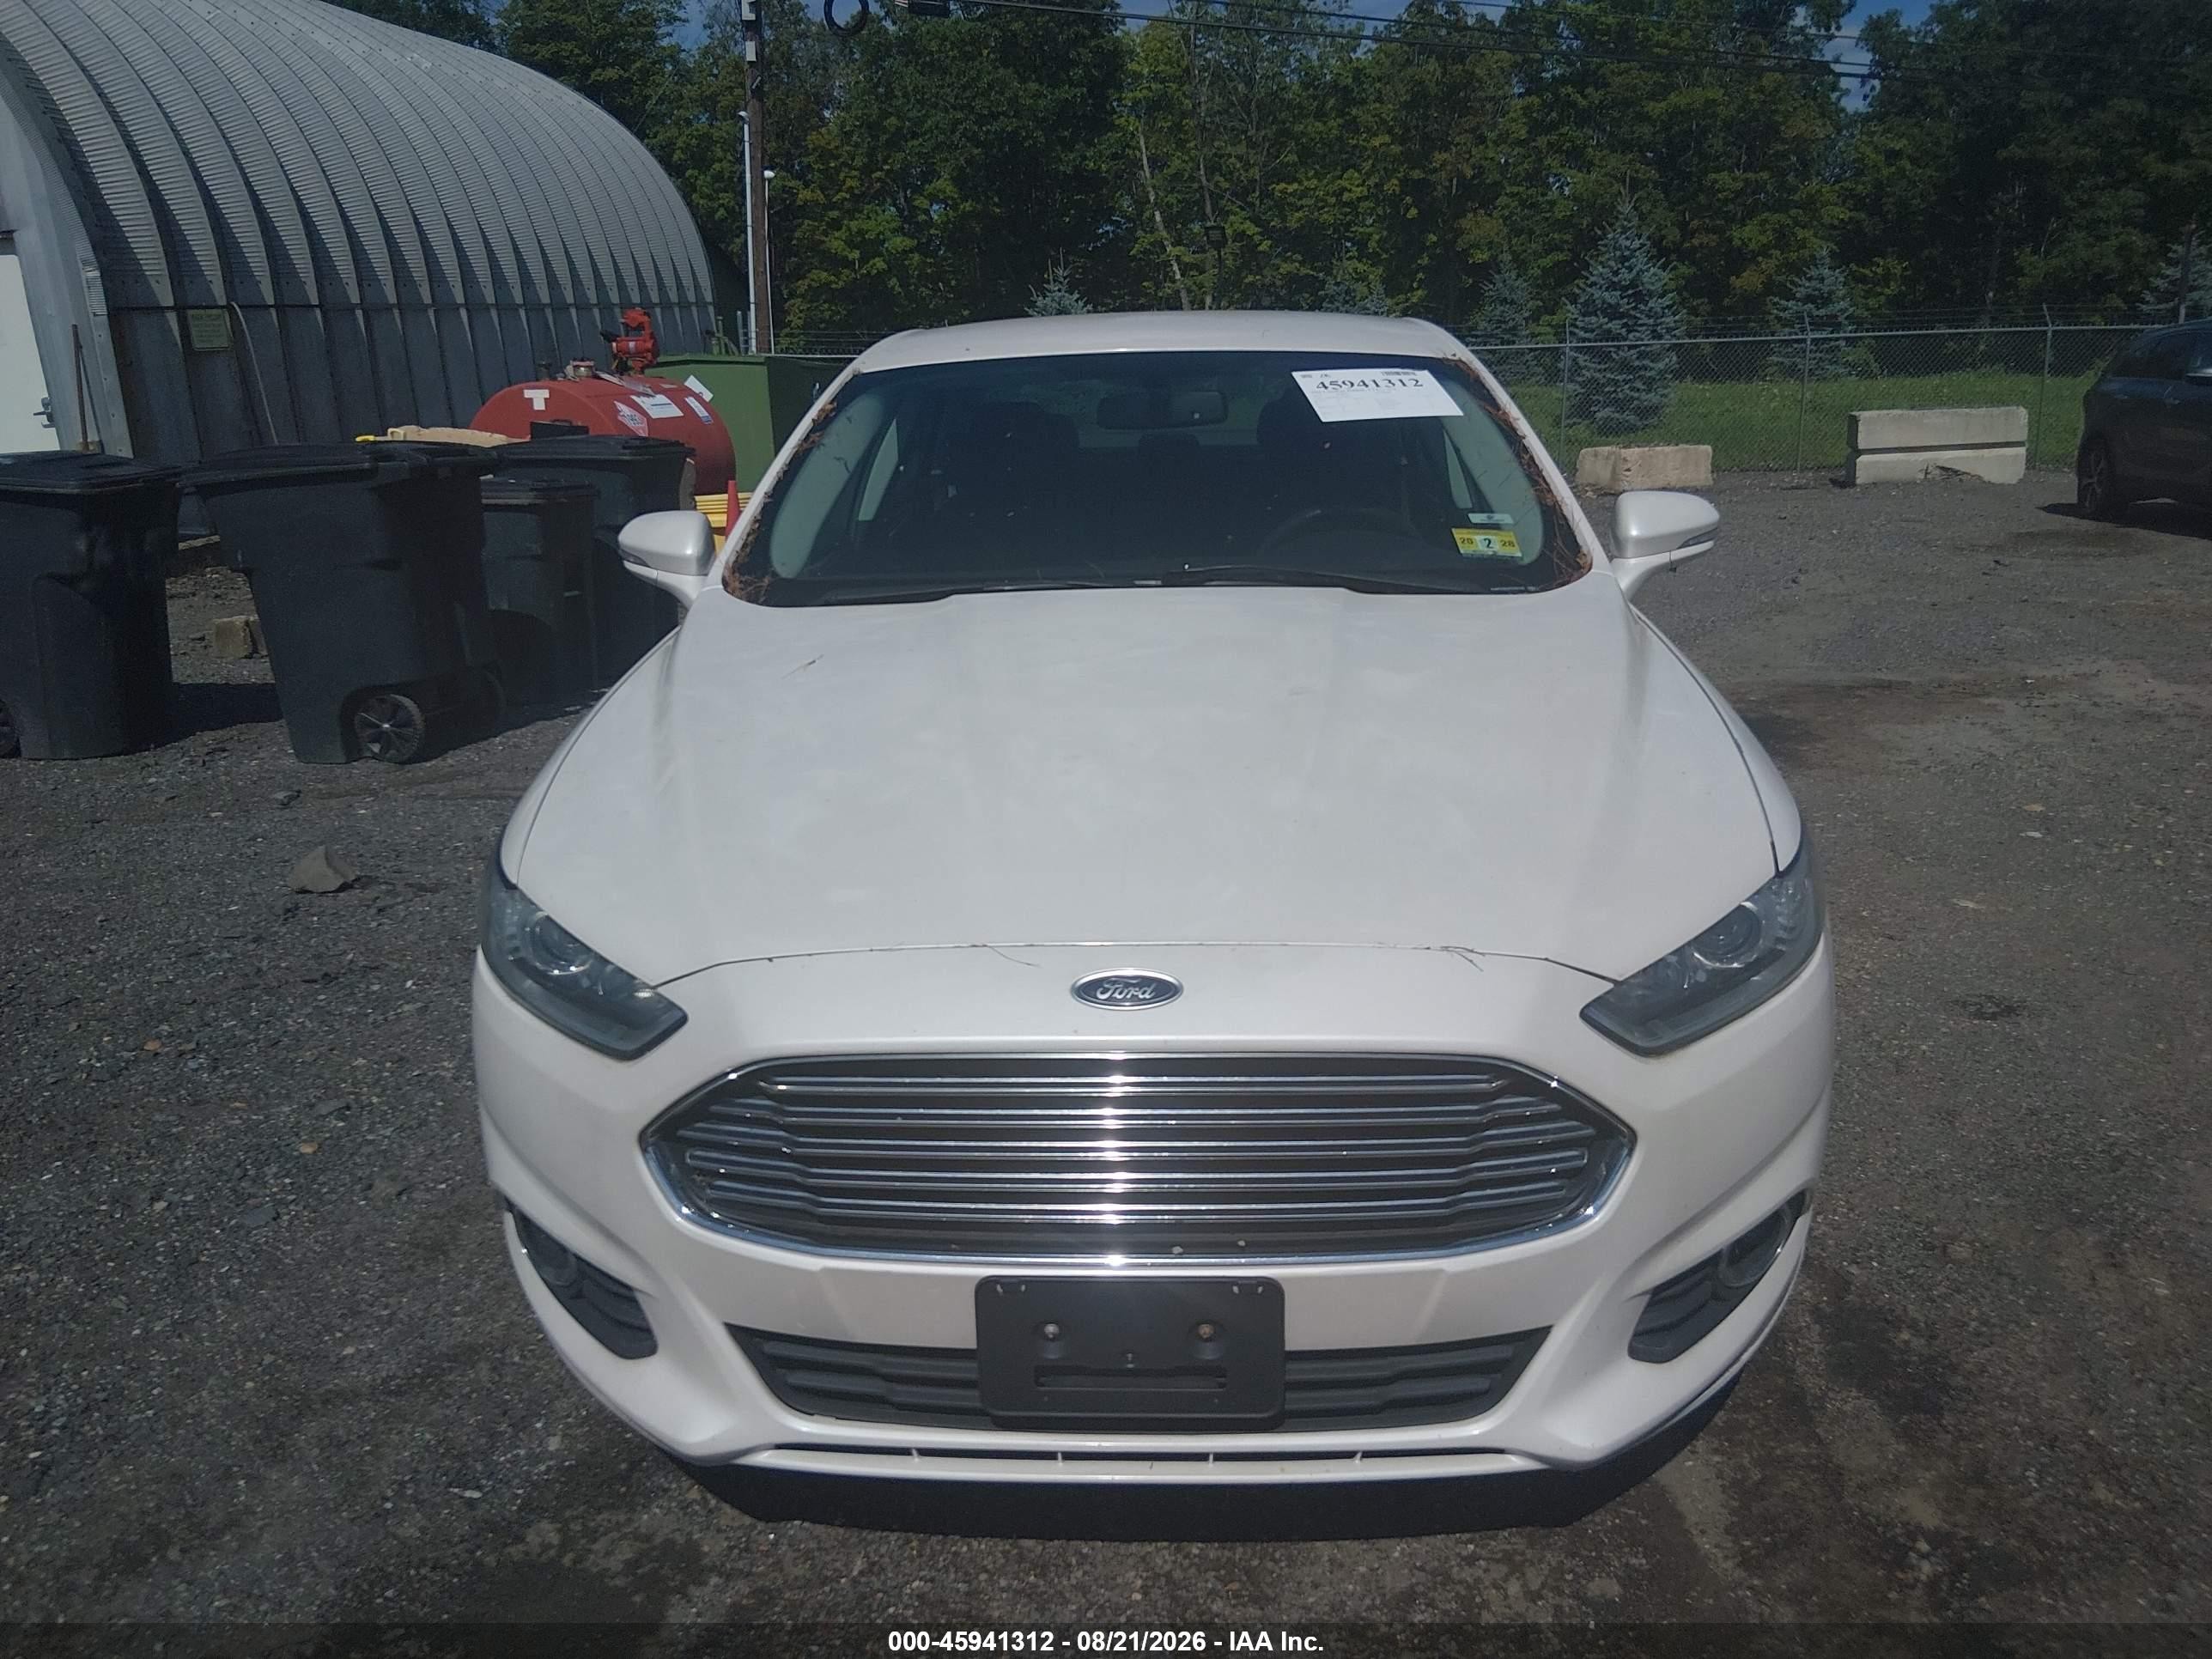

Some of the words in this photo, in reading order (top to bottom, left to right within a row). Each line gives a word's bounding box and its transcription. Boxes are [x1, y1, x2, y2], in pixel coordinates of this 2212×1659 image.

[1316, 378, 1424, 391] 45941312
[1483, 538, 1493, 549] 2
[1096, 977, 1158, 1000] Ford
